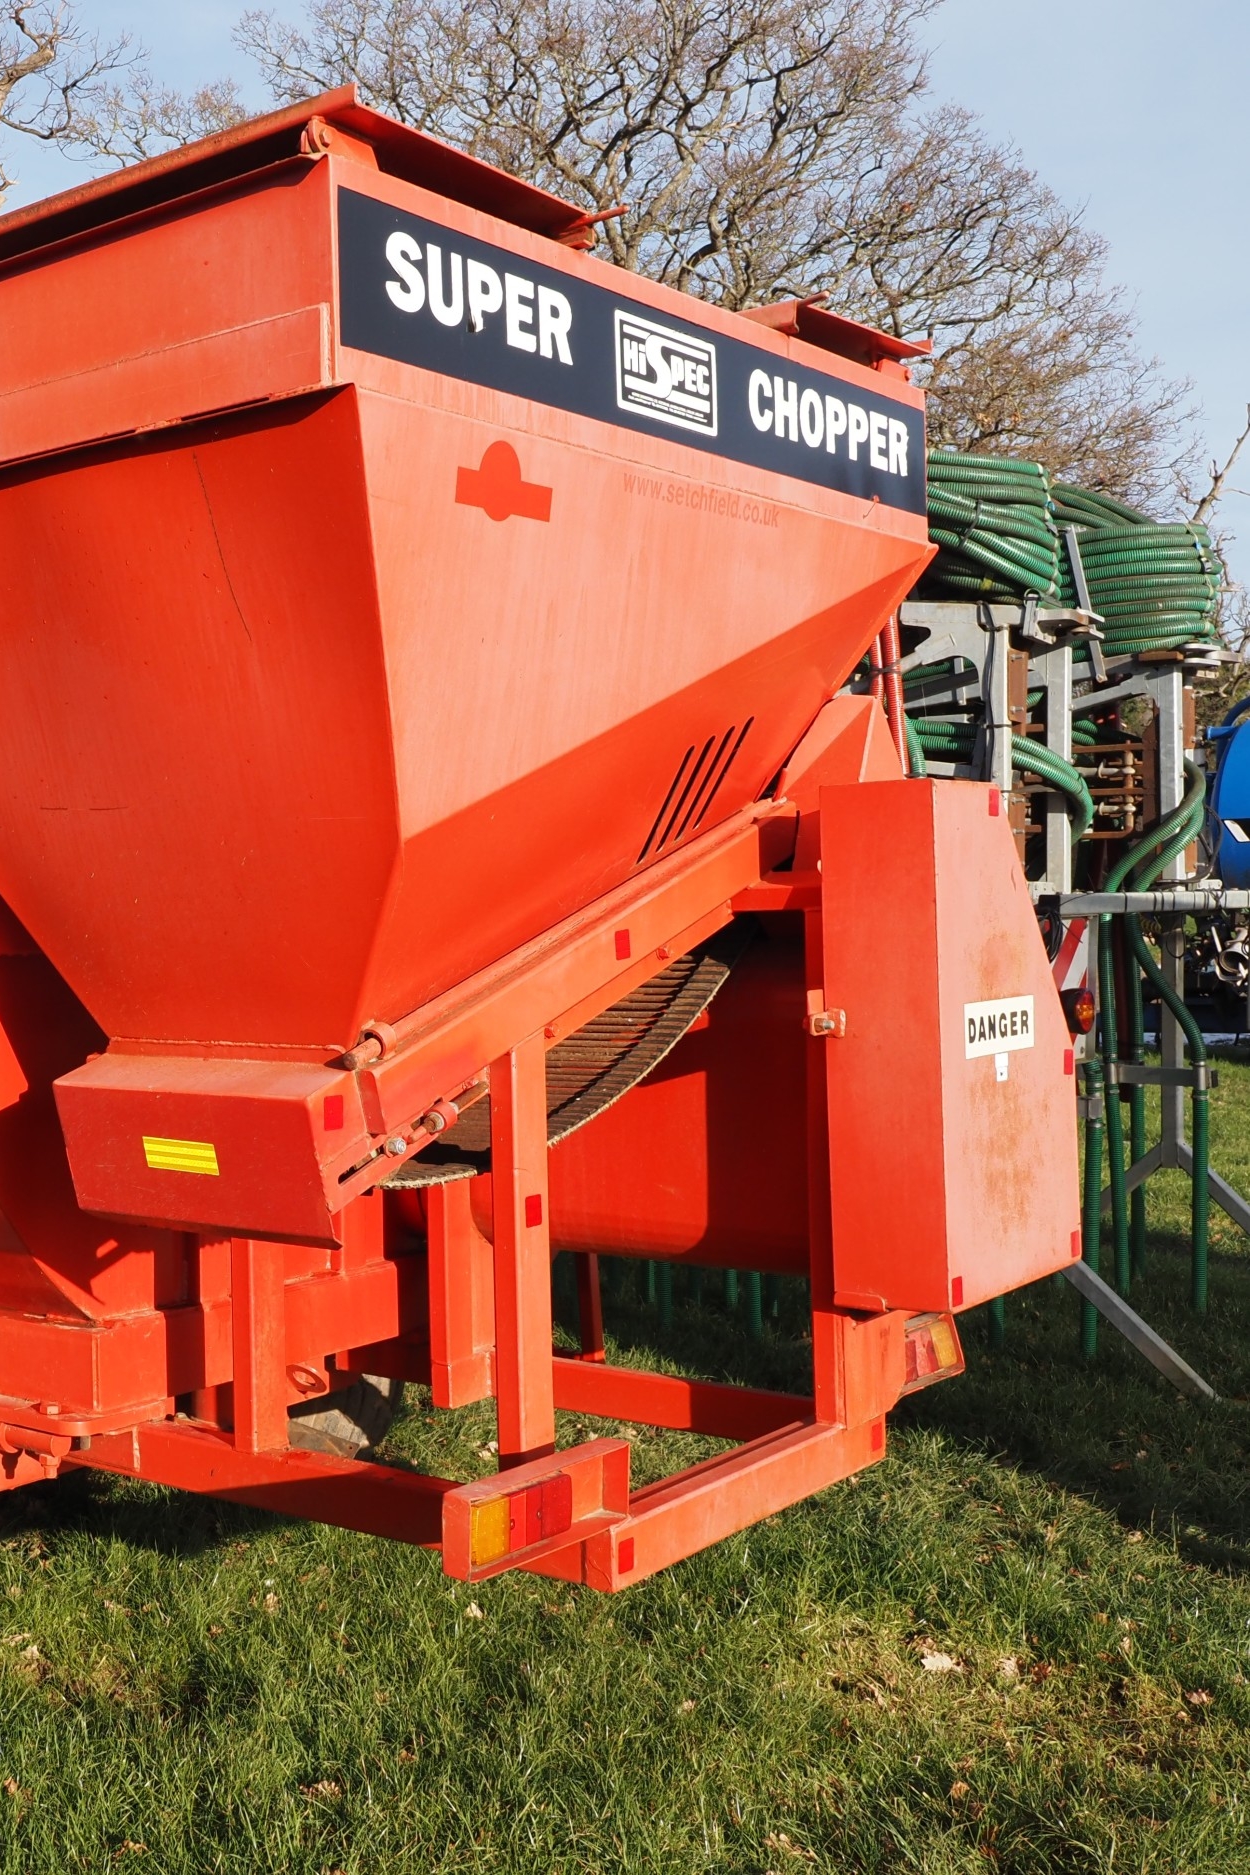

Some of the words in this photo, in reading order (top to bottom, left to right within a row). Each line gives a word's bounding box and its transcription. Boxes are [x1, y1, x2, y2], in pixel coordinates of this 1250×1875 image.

[385, 231, 574, 366] SUPER
[748, 368, 909, 477] CHOPPER
[623, 472, 780, 528] www.setchfield.co.uk
[967, 1009, 1030, 1044] DANGER
